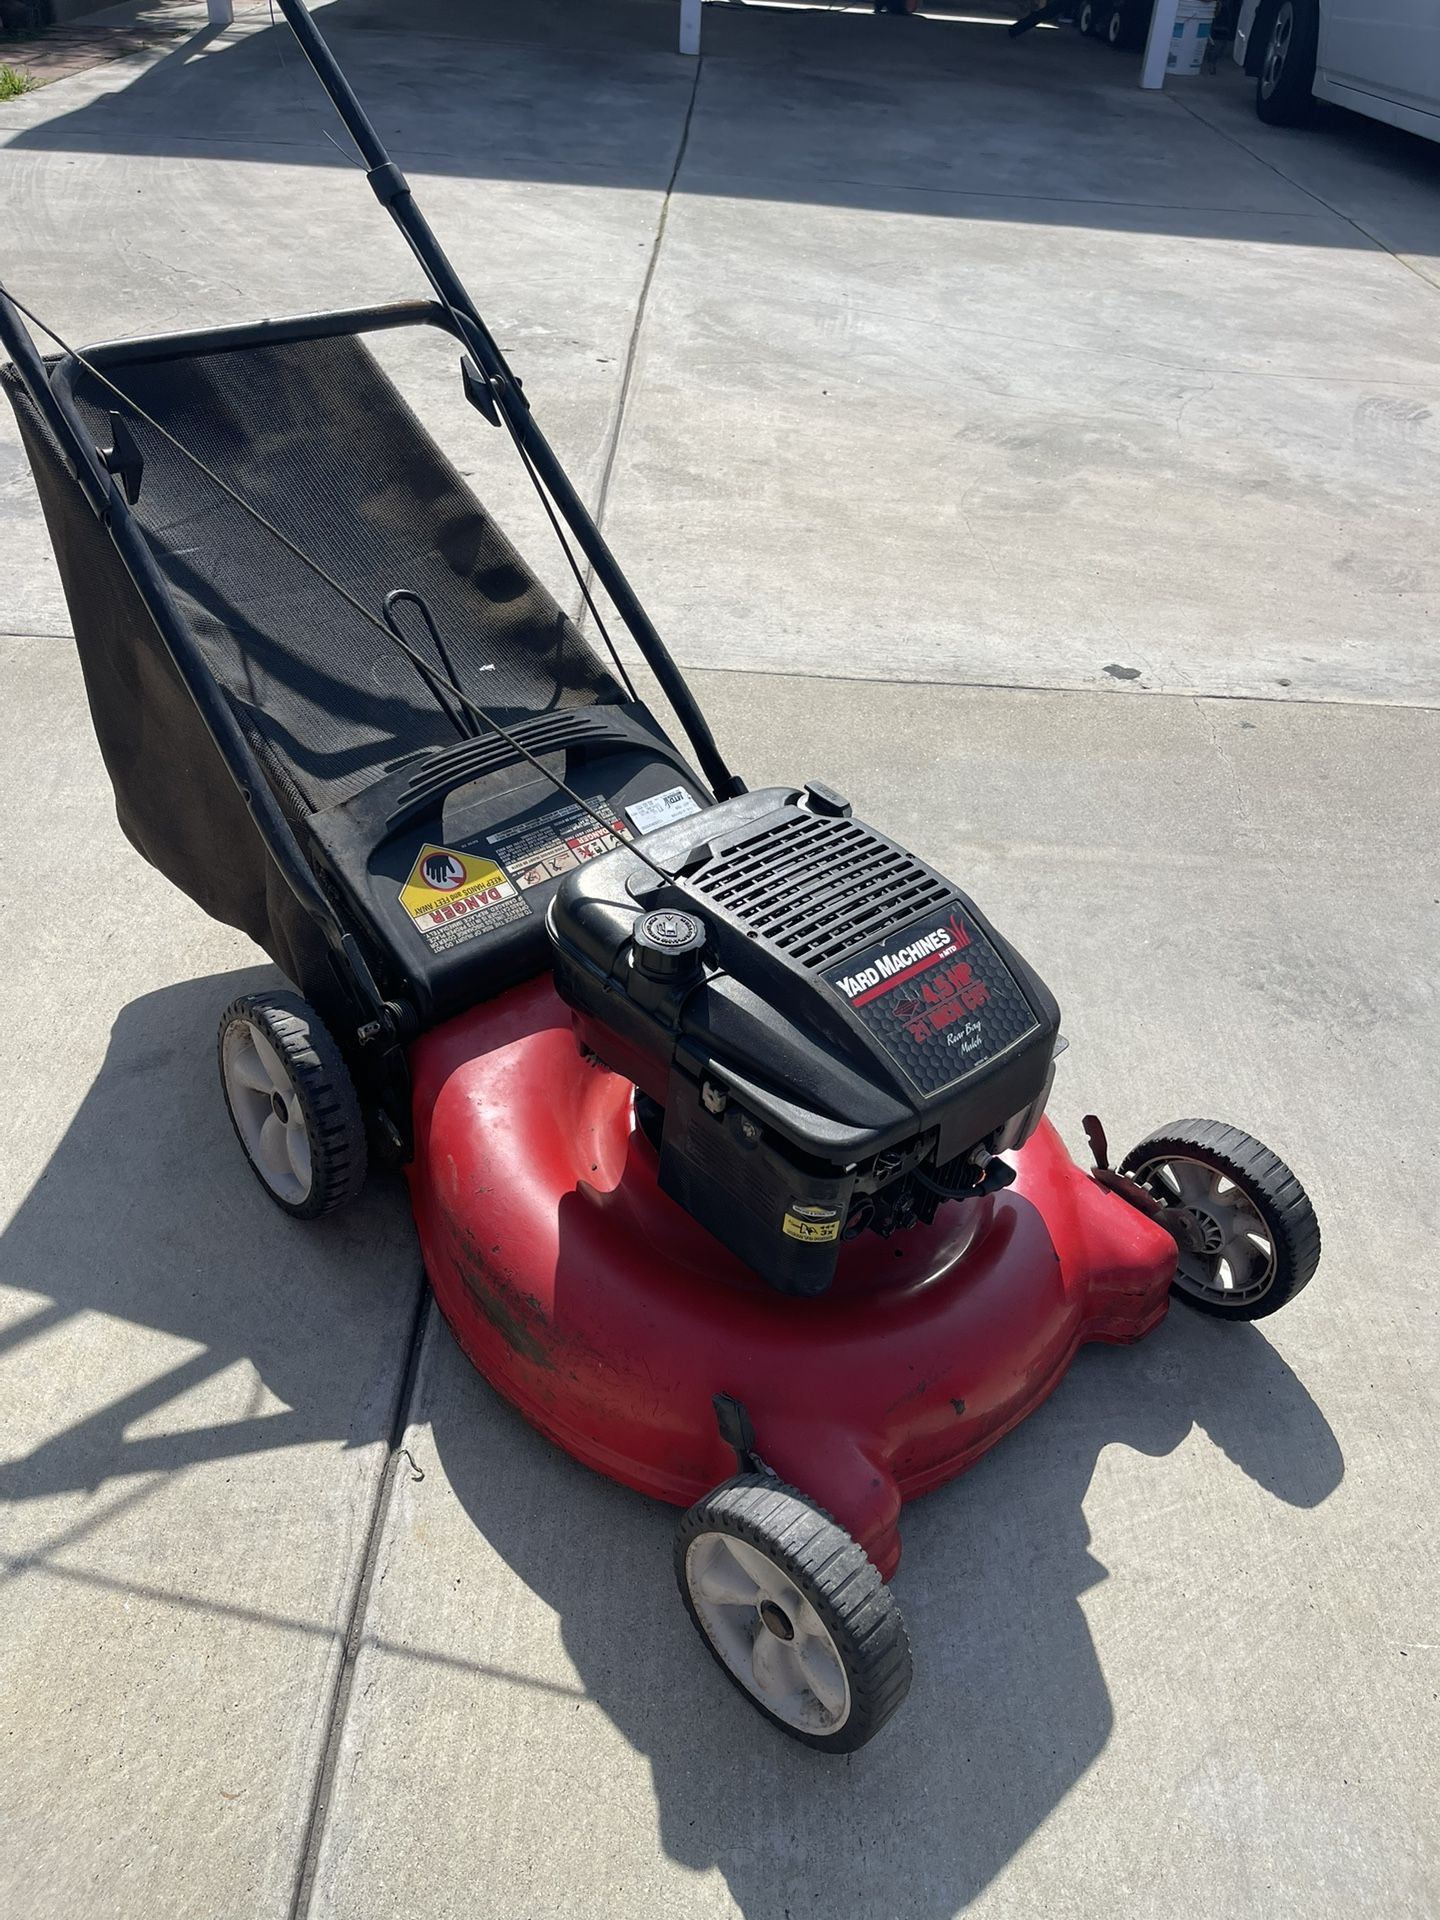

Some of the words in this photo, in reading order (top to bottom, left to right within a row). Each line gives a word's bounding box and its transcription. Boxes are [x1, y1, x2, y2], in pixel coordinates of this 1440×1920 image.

[576, 826, 608, 845] DANGER
[462, 883, 485, 896] HANDS
[486, 876, 502, 888] KEEP
[433, 896, 449, 907] FEET
[450, 891, 461, 901] and
[414, 904, 432, 915] AWAY
[429, 888, 502, 924] DANGER
[432, 944, 445, 953] NOT
[943, 945, 957, 957] MTD
[836, 967, 880, 998] YARD
[874, 928, 951, 978] MACHINES
[945, 961, 972, 989] HP
[907, 1020, 932, 1044] 21
[946, 1030, 965, 1046] Rear
[965, 1020, 981, 1036] Bag
[961, 1034, 982, 1056] Mulch
